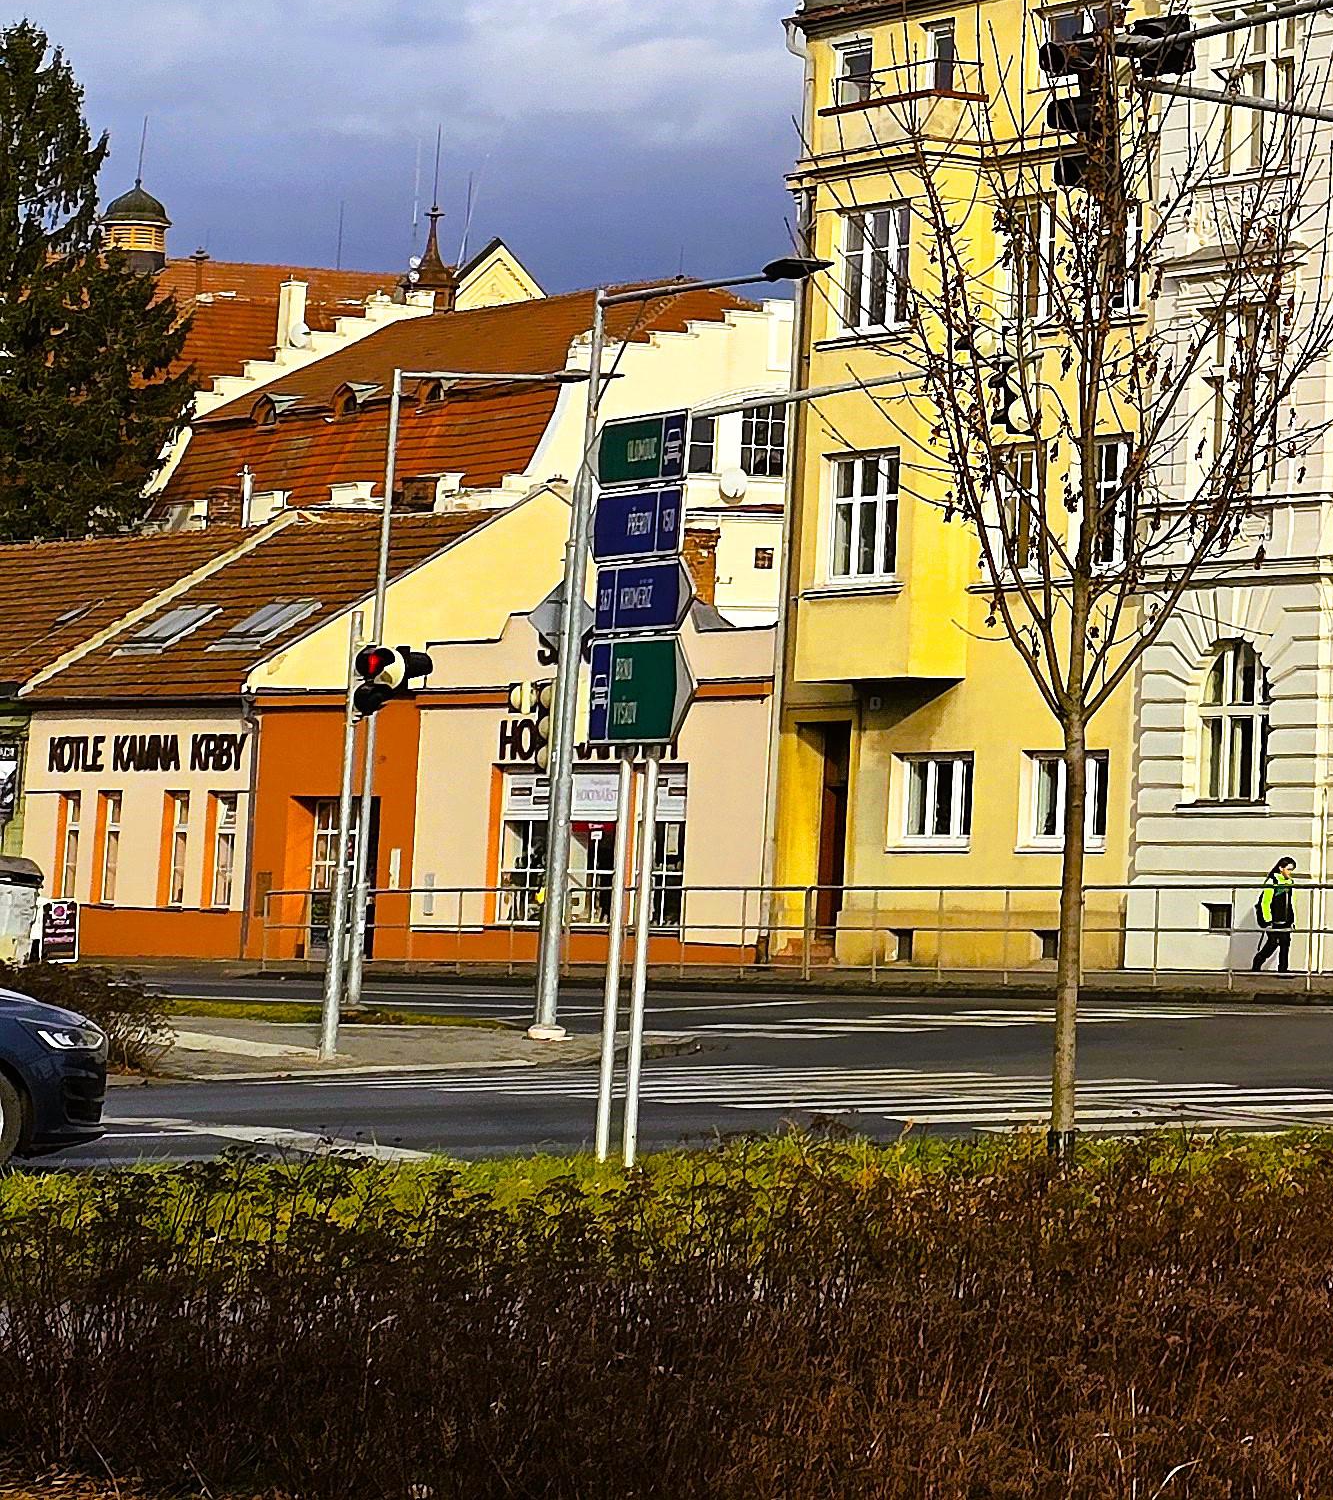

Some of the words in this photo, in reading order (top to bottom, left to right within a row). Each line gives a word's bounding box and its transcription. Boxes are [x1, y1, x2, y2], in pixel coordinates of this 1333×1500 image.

[627, 437, 657, 462] OLOMOUC
[48, 735, 106, 773] KOTLE
[112, 734, 181, 773] KAMNA
[190, 733, 249, 772] KRBY
